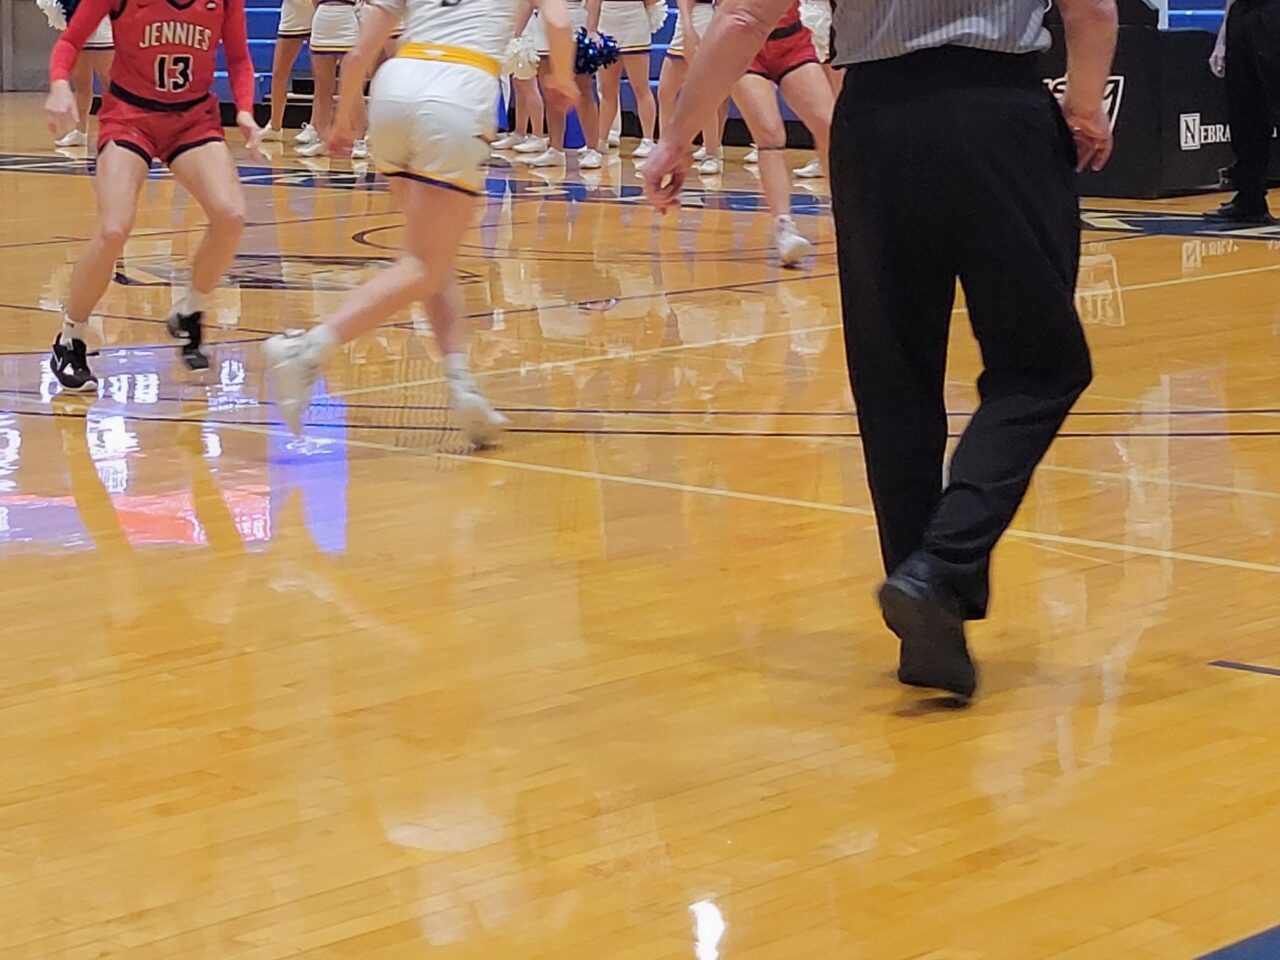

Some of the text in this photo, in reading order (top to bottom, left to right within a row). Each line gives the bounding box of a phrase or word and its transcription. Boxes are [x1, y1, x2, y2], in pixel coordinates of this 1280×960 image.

[138, 21, 212, 51] JENNIES
[154, 54, 193, 93] 13
[1180, 113, 1232, 150] NEBRA
